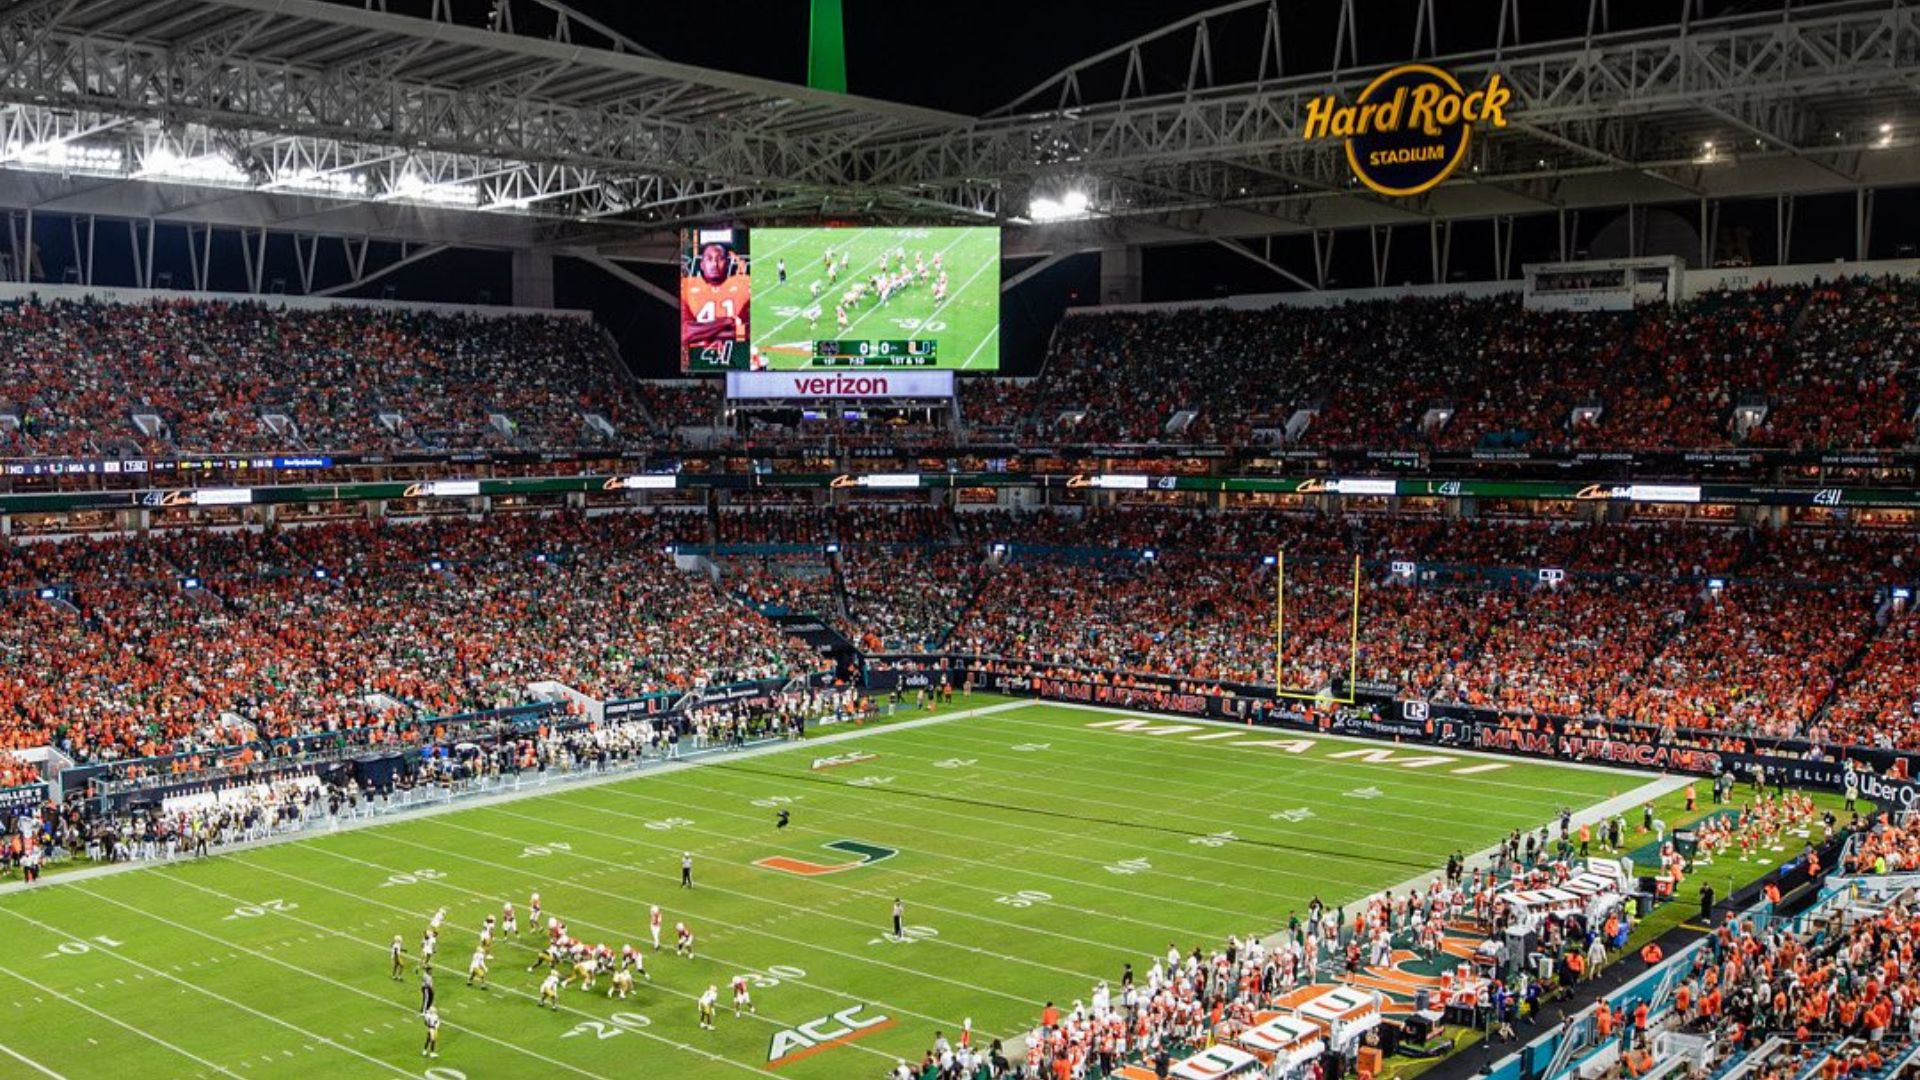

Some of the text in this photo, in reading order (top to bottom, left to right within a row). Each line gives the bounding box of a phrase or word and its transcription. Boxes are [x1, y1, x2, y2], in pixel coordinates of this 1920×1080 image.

[1304, 73, 1511, 140] Hard Rock
[1369, 145, 1445, 166] STADIUM
[696, 300, 734, 323] 41
[701, 340, 733, 365] 41
[860, 342, 869, 355] 0
[881, 342, 890, 355] 0
[794, 374, 888, 395] verizon
[69, 464, 85, 473] MIA
[1813, 489, 1842, 505] 41
[1085, 718, 1511, 775] MIAMI
[1795, 768, 1841, 784] ELLIS
[1860, 774, 1899, 802] Uber
[750, 839, 900, 876] U
[735, 964, 807, 988] 30
[573, 1012, 652, 1041] 20
[768, 1003, 890, 1062] ACC
